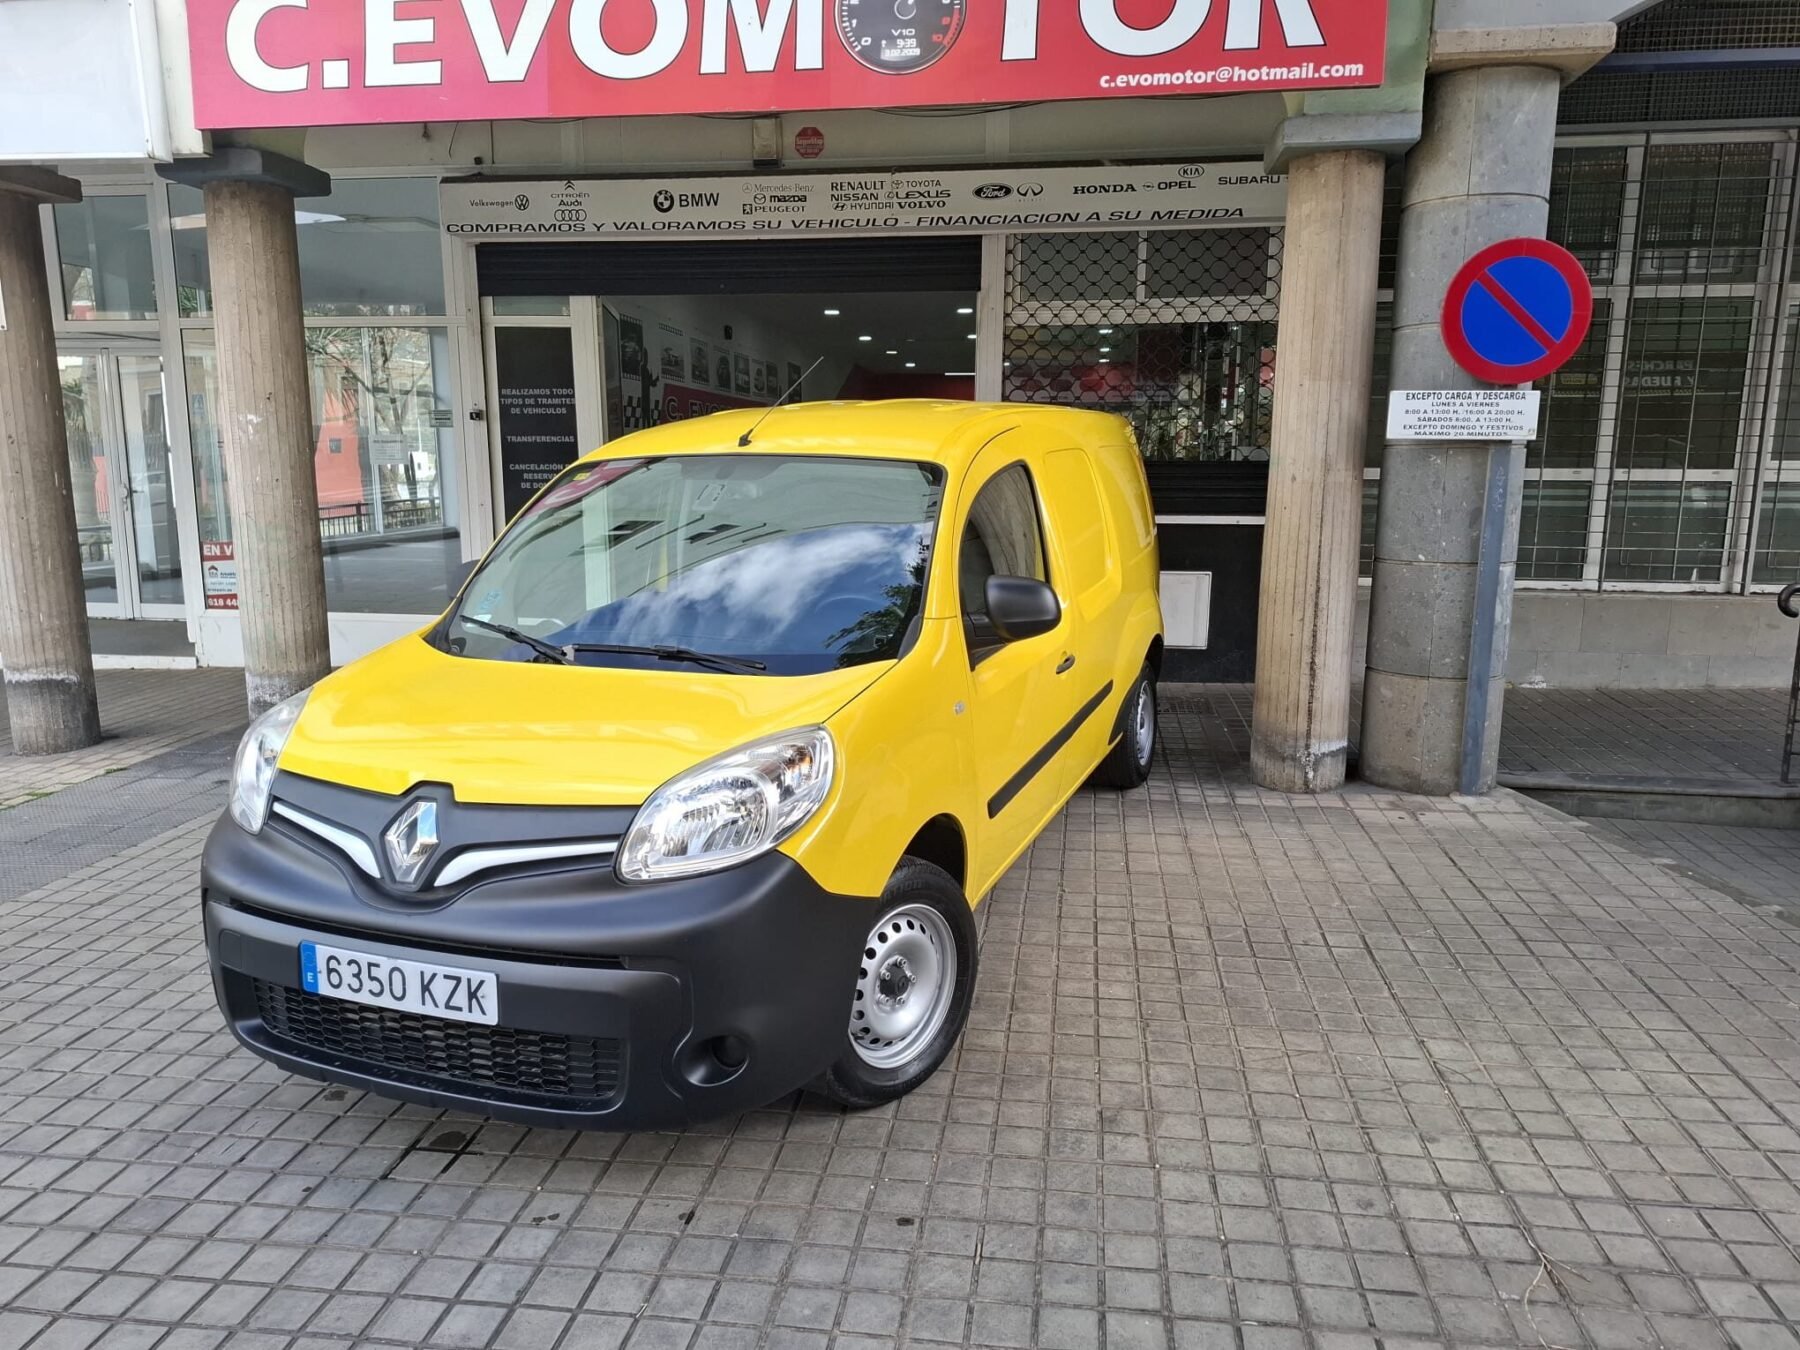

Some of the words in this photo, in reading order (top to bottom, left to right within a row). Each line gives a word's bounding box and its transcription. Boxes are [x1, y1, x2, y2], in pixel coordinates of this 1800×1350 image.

[891, 28, 916, 37] V10
[1099, 60, 1364, 89] c.evomotor@hotmail.com
[1182, 167, 1200, 176] KIA
[906, 179, 942, 188] TOYOTA
[1218, 175, 1281, 185] SUBARU
[754, 183, 815, 193] Mercedes-Benz
[830, 180, 887, 192] RENAULT
[1072, 183, 1137, 195] HONDA
[1157, 181, 1197, 190] OPEL
[830, 192, 879, 202] NISSAN
[895, 189, 951, 200] LEXUS
[980, 186, 1006, 198] Ford
[469, 198, 514, 208] Volkswagen
[558, 199, 583, 207] Audi
[679, 192, 720, 208] BMW
[896, 200, 947, 210] VOLVO
[754, 205, 806, 213] PEUGEOT
[850, 201, 894, 210] HYUNDAI
[446, 222, 586, 233] COMPRAMOS
[592, 222, 607, 232] Y
[612, 219, 746, 231] VALORAMOS
[752, 219, 782, 230] SU
[791, 217, 899, 228] VEHICULO
[916, 212, 1081, 226] FINANCIACION
[1086, 211, 1101, 222] A
[1108, 210, 1142, 221] SU
[1150, 207, 1244, 220] MEDIDA
[1405, 392, 1442, 400] EXCEPTO
[1445, 392, 1472, 400] CARGA
[1475, 392, 1481, 400] Y
[1483, 391, 1526, 400] DESCARGA
[506, 435, 575, 443] TRANSFERENCIAS
[203, 544, 220, 556] EN
[307, 972, 314, 982] E
[326, 955, 407, 1002] 6350
[420, 970, 488, 1017] KZK
